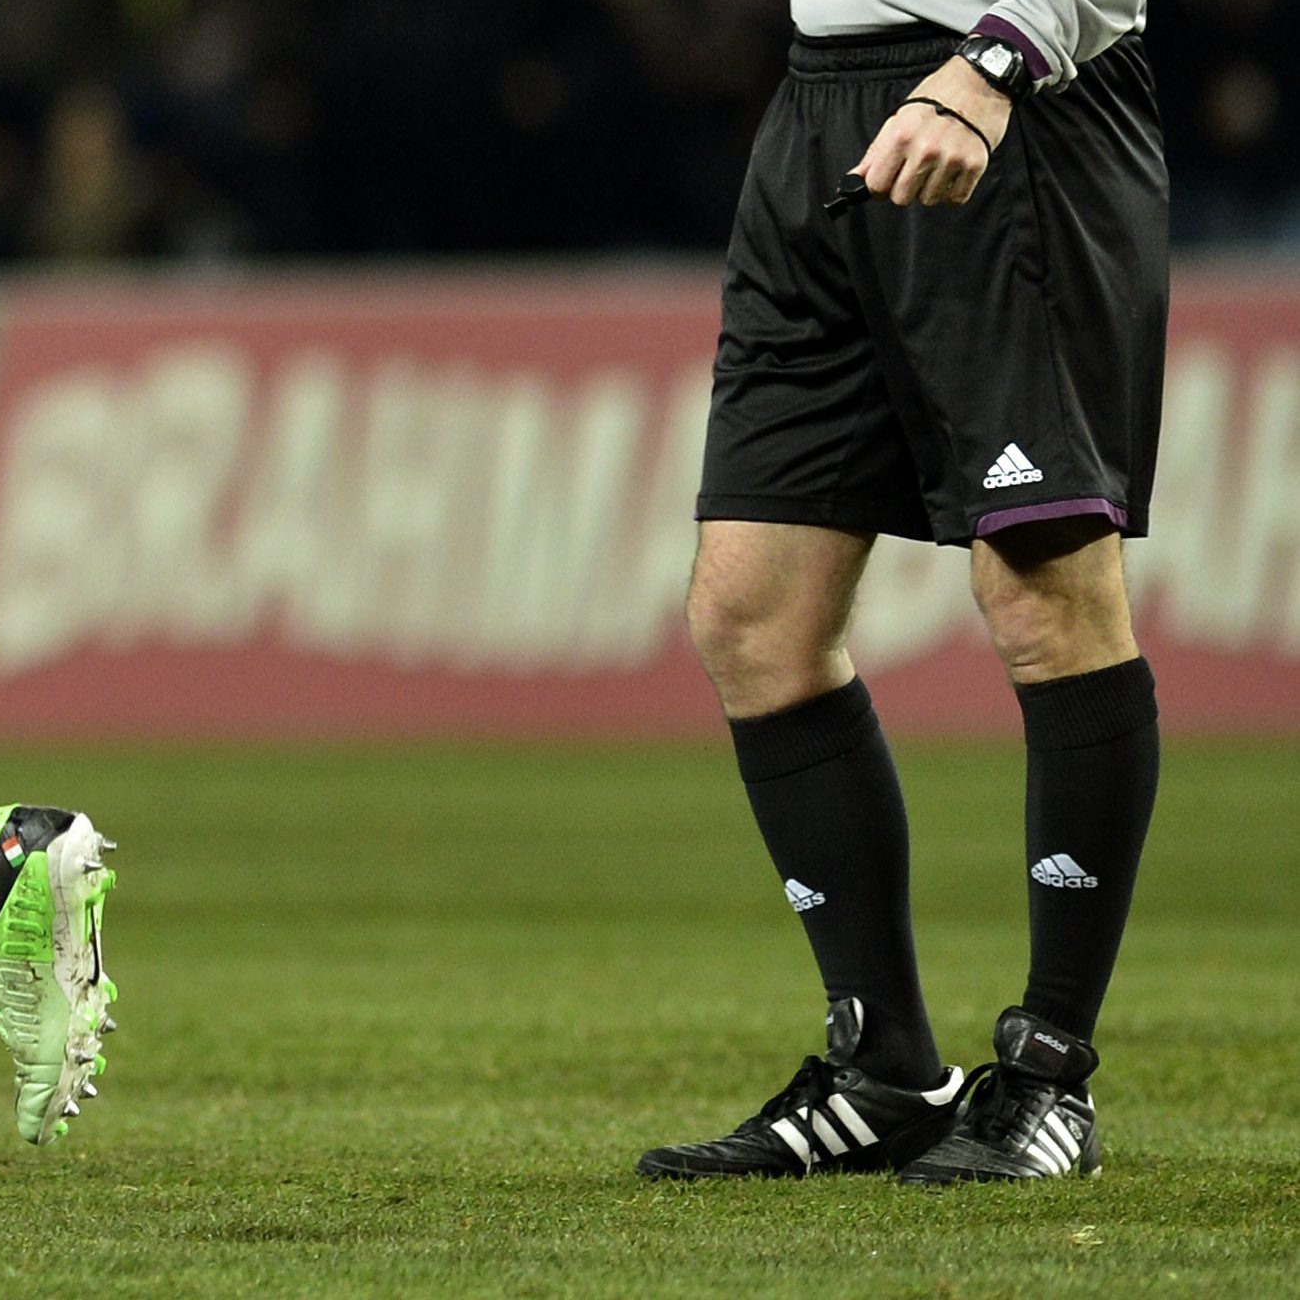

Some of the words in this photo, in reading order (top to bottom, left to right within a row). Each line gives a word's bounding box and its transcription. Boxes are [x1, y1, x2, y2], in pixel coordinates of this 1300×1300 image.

[983, 469, 1043, 489] adidas
[1031, 866, 1099, 889] adidas
[1034, 1032, 1069, 1055] adidas
